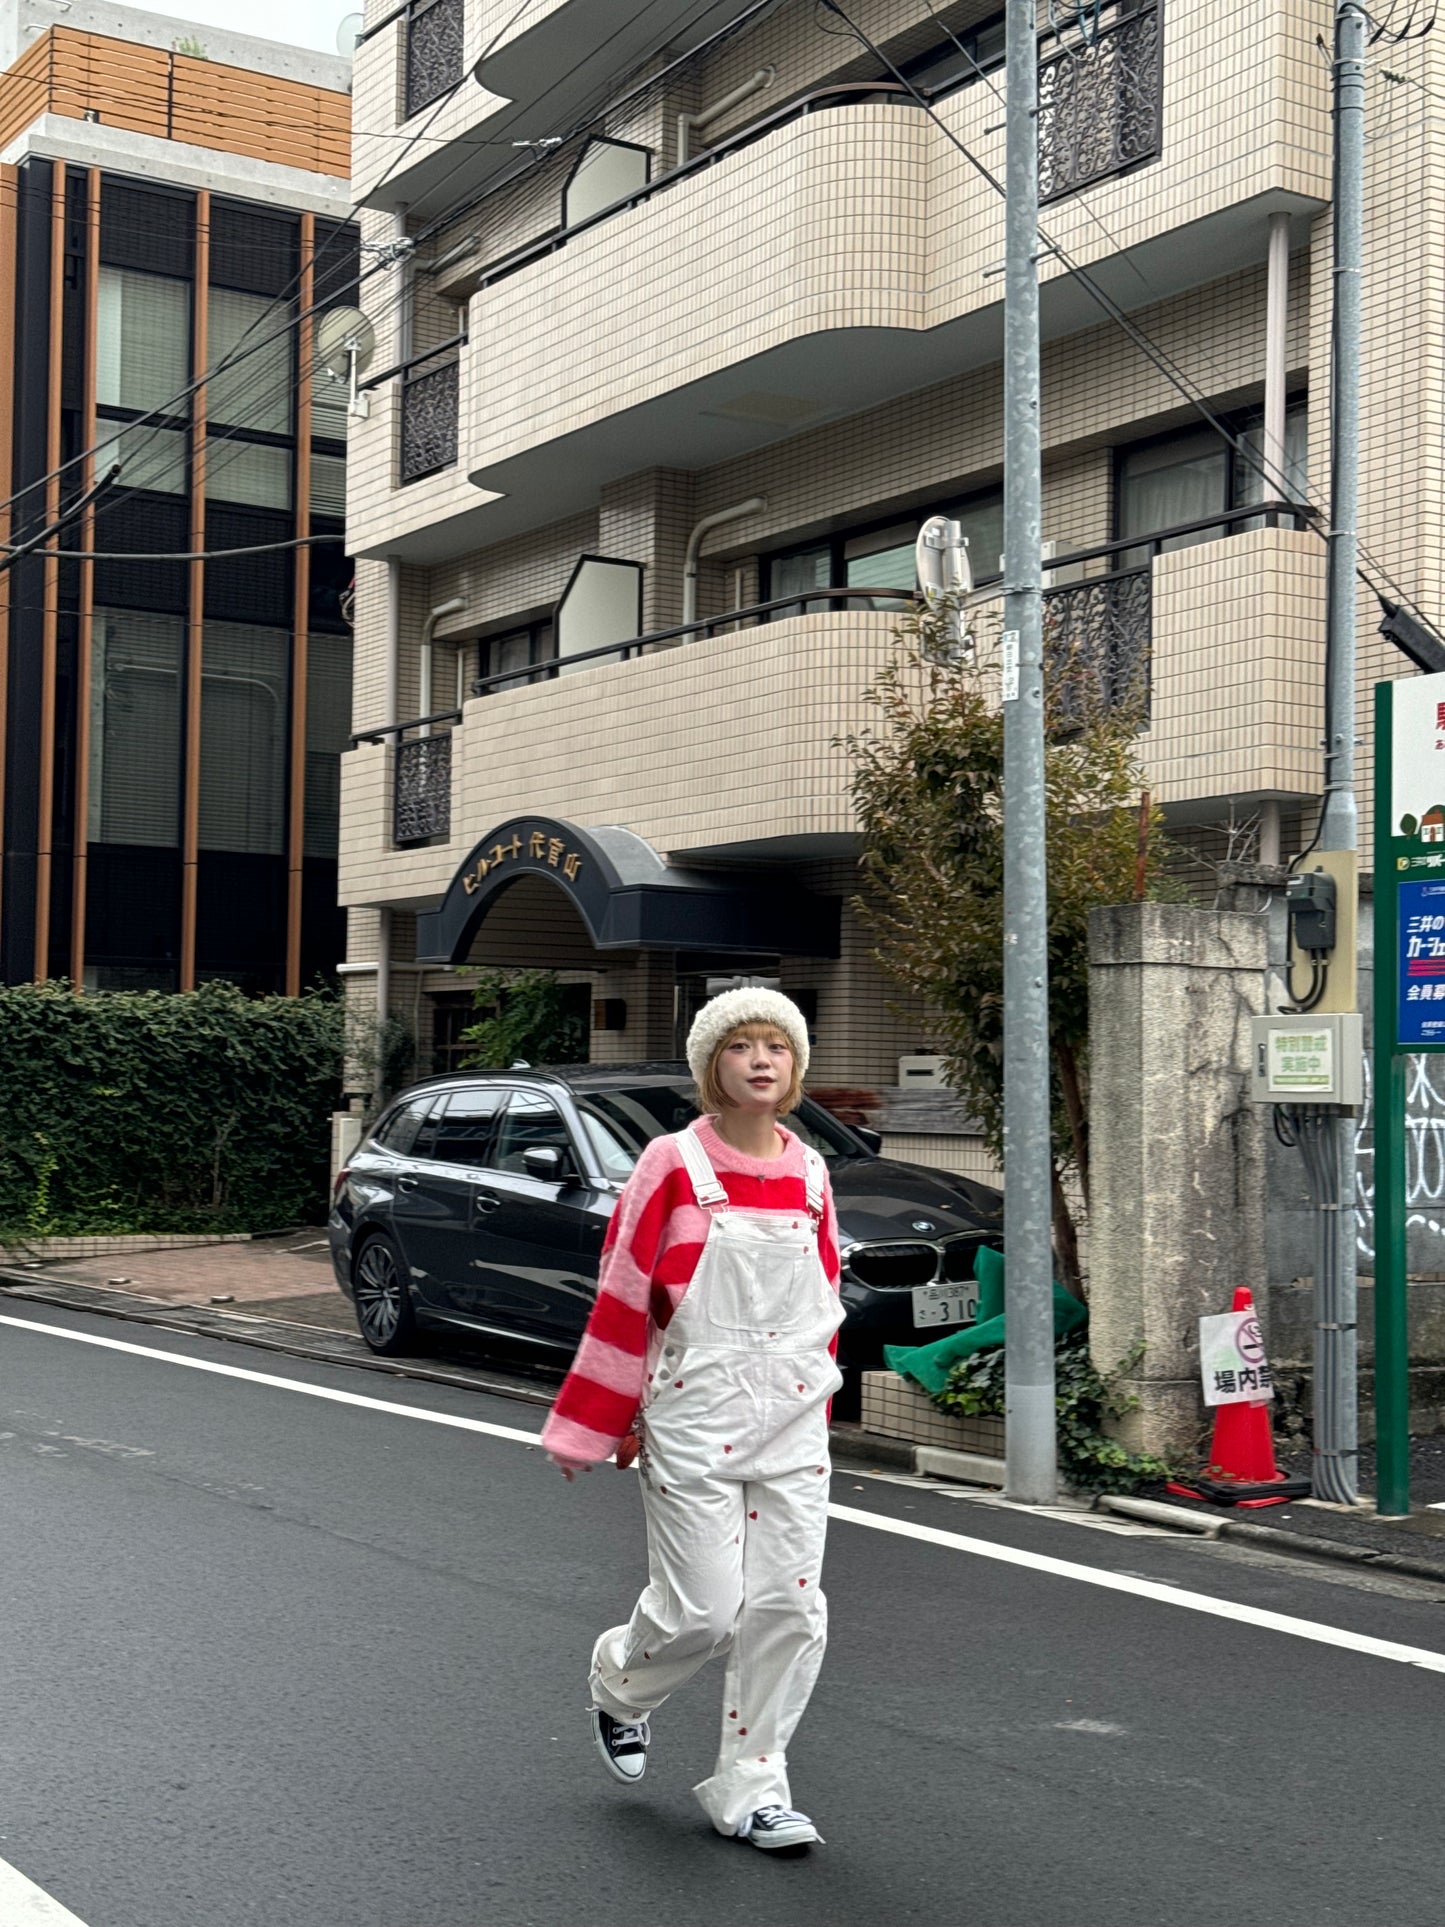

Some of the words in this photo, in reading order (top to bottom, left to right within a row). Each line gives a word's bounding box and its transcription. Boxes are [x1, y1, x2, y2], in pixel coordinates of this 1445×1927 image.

[462, 833, 523, 895] ヒルコート
[529, 831, 583, 882] 代官山
